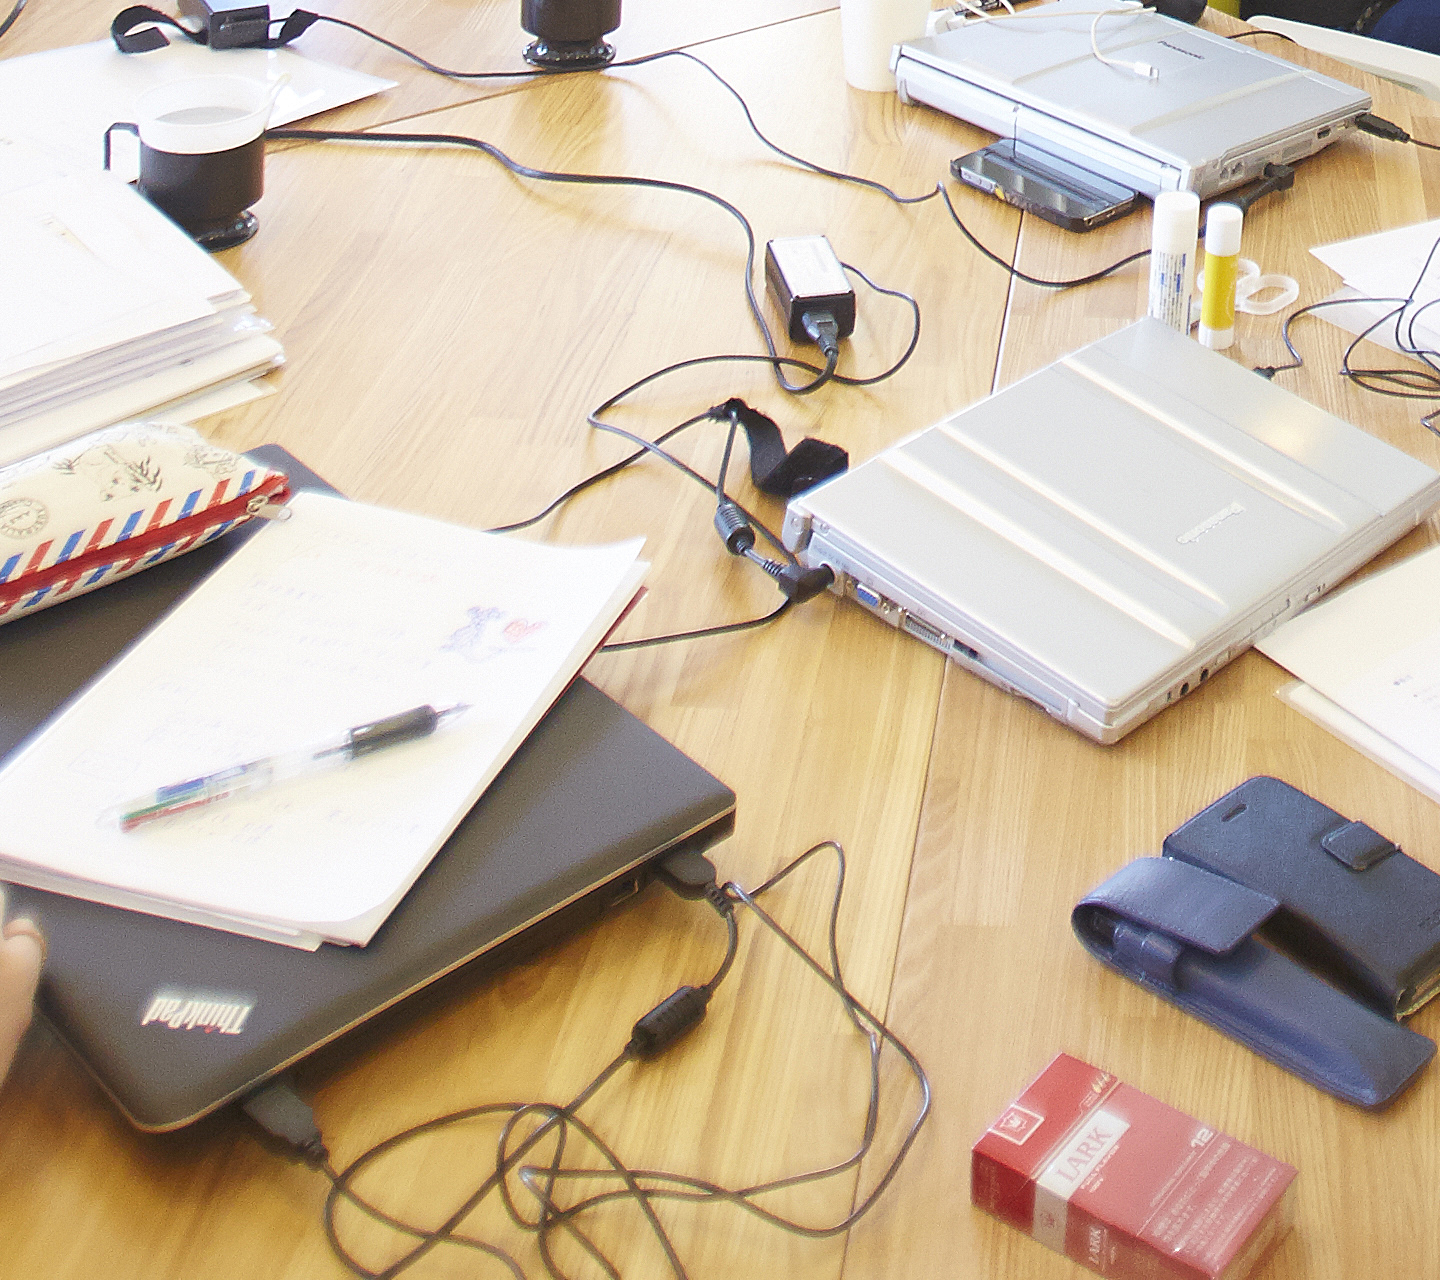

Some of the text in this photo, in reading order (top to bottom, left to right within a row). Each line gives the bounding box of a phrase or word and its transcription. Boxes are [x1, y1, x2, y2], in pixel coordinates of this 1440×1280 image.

[141, 998, 251, 1035] ThinkPad
[1054, 1127, 1113, 1183] LARK
[1191, 1128, 1213, 1148] 12
